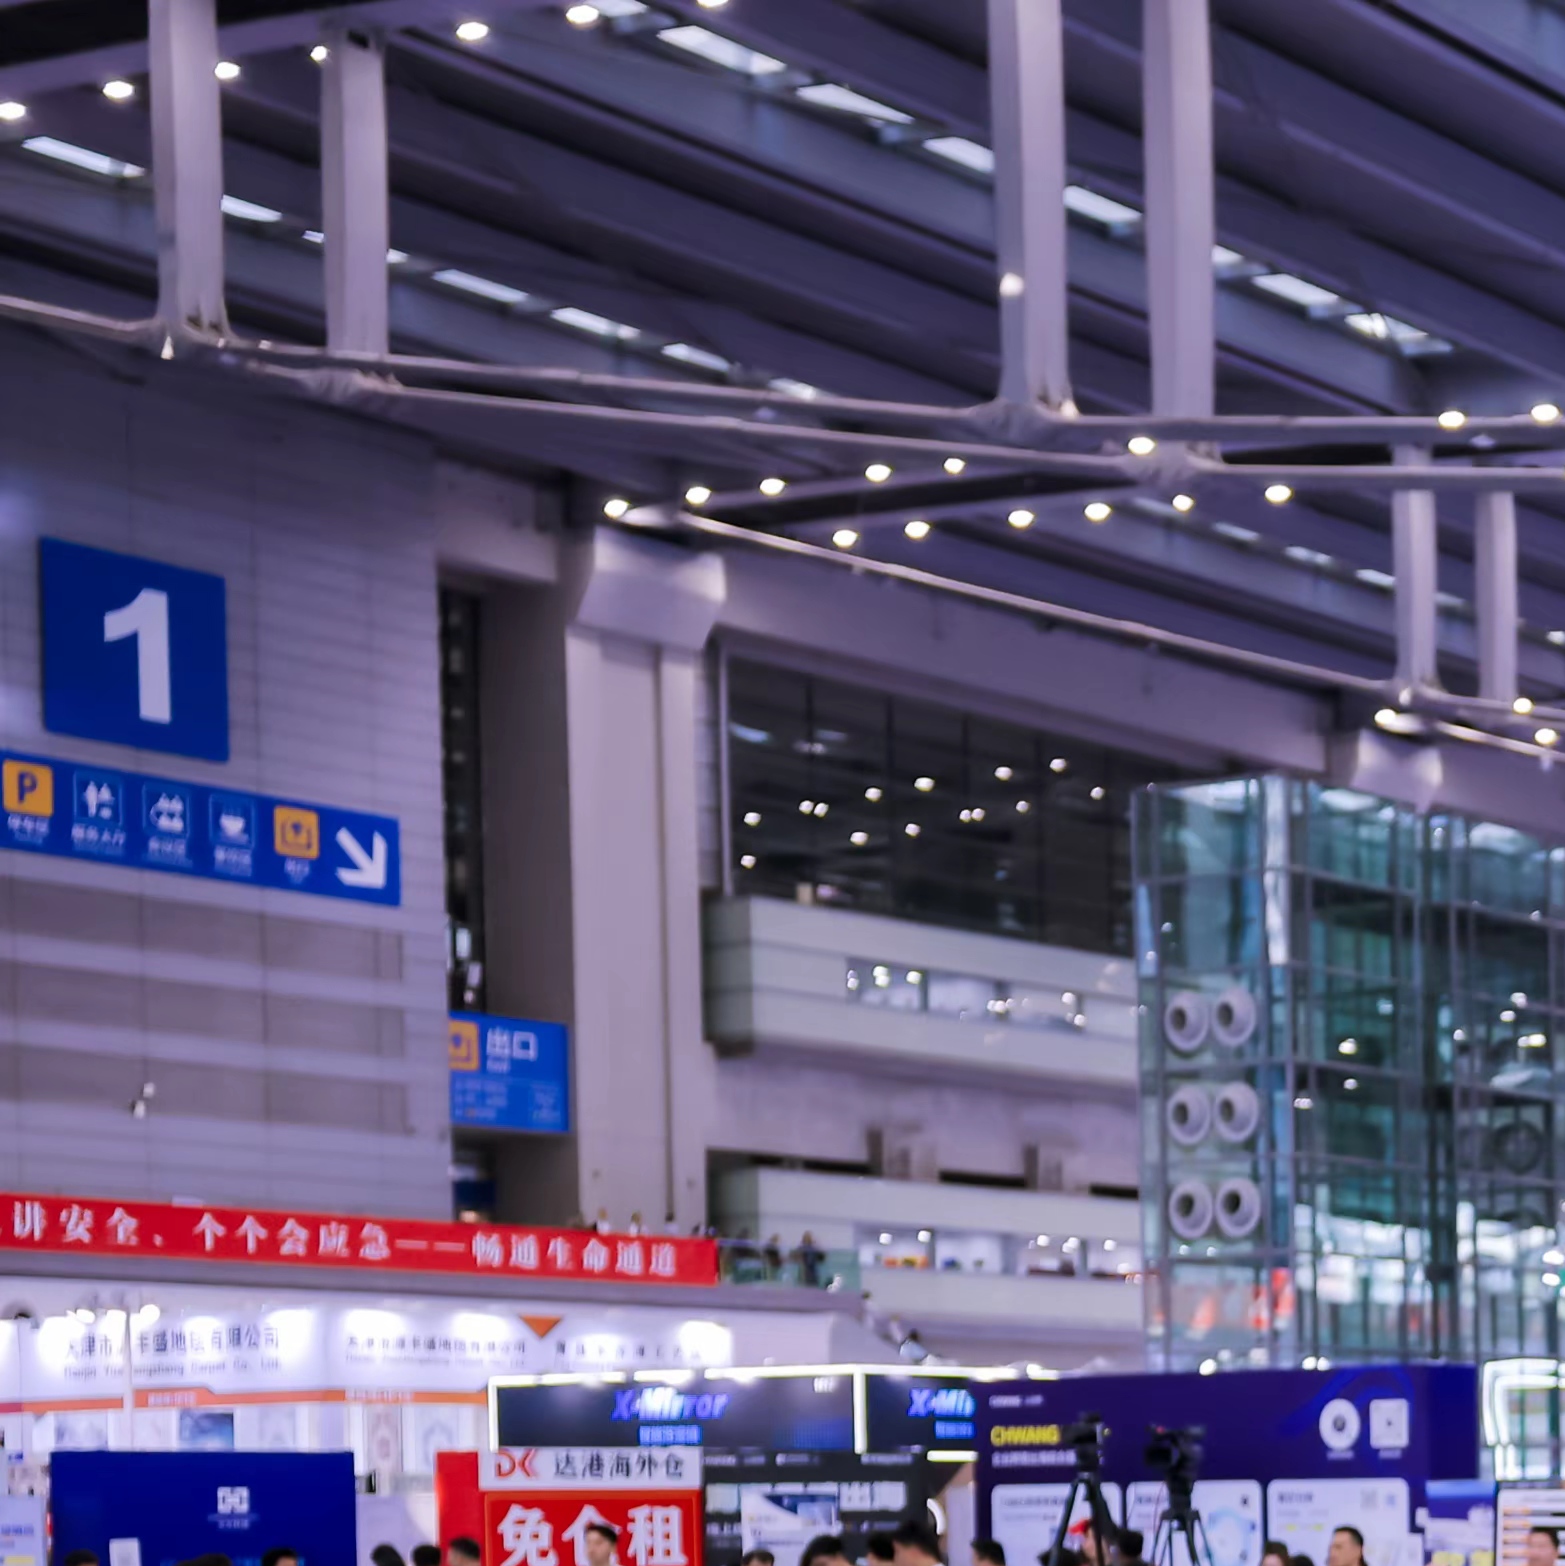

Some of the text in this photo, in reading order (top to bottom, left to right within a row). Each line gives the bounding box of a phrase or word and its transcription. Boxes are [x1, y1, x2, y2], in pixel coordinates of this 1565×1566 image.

[104, 588, 172, 724] 1
[486, 1026, 539, 1062] 出口
[554, 1452, 684, 1481] 达港海外仓
